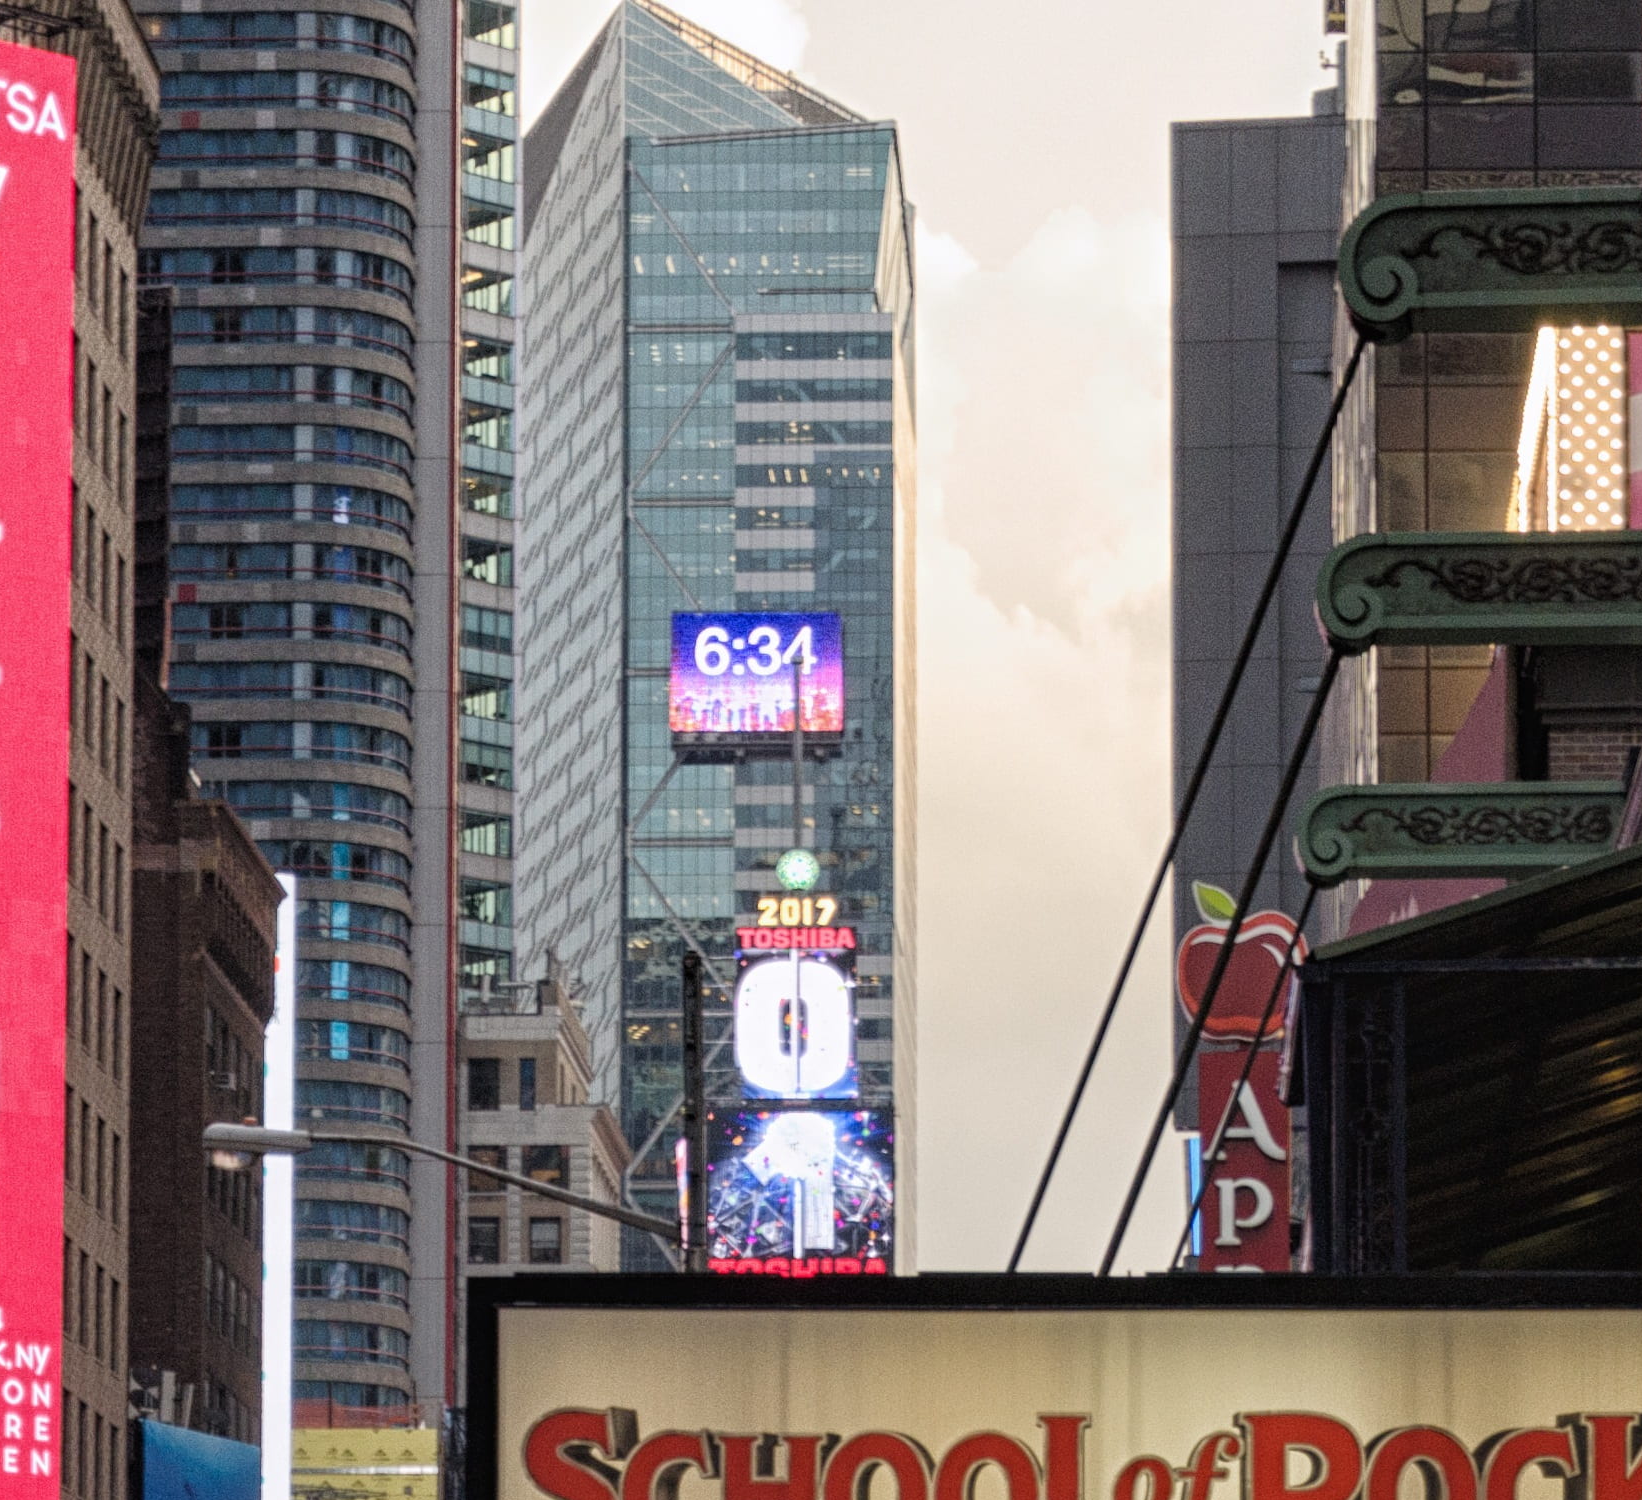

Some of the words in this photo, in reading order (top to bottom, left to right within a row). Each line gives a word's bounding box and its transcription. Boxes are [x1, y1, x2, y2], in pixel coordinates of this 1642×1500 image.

[694, 626, 817, 676] 6:34
[757, 897, 838, 926] 2017
[737, 926, 855, 949] TOSHIBA
[14, 1343, 51, 1375] NY
